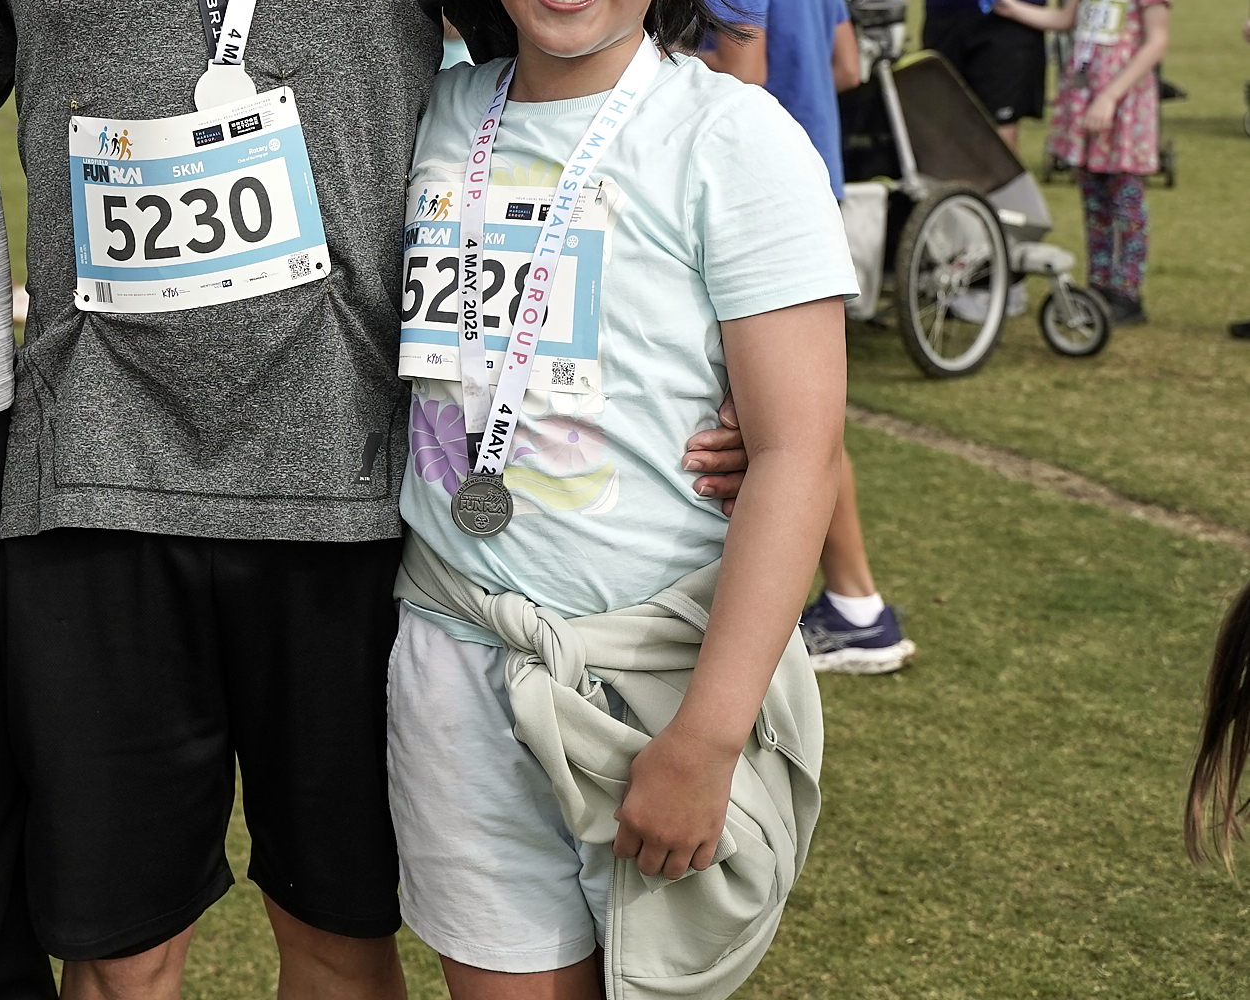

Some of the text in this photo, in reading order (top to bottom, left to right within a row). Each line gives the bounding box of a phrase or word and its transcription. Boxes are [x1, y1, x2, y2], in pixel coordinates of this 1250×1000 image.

[228, 28, 242, 39] 4
[231, 115, 259, 128] BRIDGE
[248, 145, 268, 155] Rotary
[82, 158, 109, 166] LINDFIELD
[172, 161, 205, 178] 5KM
[466, 118, 496, 208] GROUP.
[83, 164, 143, 185] FUN RUN
[102, 176, 272, 262] 5230
[508, 87, 638, 370] THE MARSHALL GROUP.
[417, 227, 452, 246] RUN
[483, 232, 506, 245] KM
[161, 287, 180, 298] KYDS
[461, 238, 478, 341] 4 MAY, 2025
[426, 353, 443, 364] KYDS
[498, 403, 513, 415] 4
[482, 419, 510, 461] MAY,
